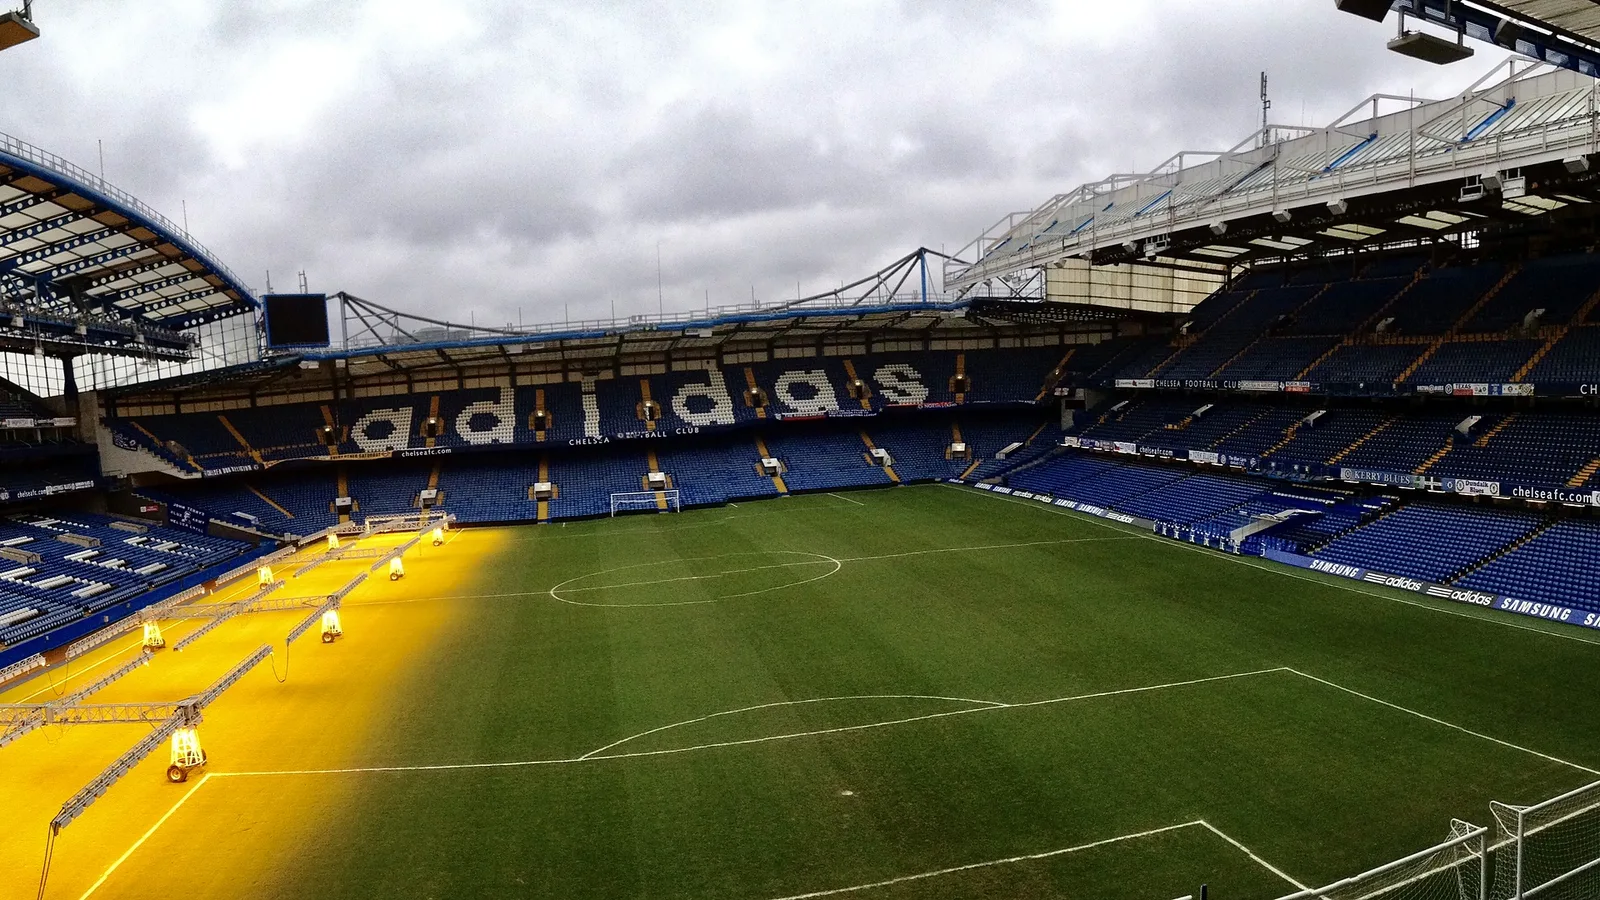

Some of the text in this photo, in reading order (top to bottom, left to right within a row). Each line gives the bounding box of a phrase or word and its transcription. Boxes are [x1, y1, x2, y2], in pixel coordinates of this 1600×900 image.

[1155, 380, 1181, 388] CHELSEA
[1184, 380, 1218, 388] FOOTBALL
[1580, 383, 1598, 395] CH
[351, 363, 929, 453] adidas
[675, 427, 700, 435] CLUB
[401, 447, 452, 457] chelseafc.com
[1354, 470, 1411, 485] KERRY BLUES
[1512, 485, 1593, 504] chelseafc.com
[1309, 559, 1358, 578] SAMSUNG
[1385, 576, 1422, 591] adidas
[1451, 588, 1493, 606] adidas
[1501, 597, 1572, 621] SAMSUNG
